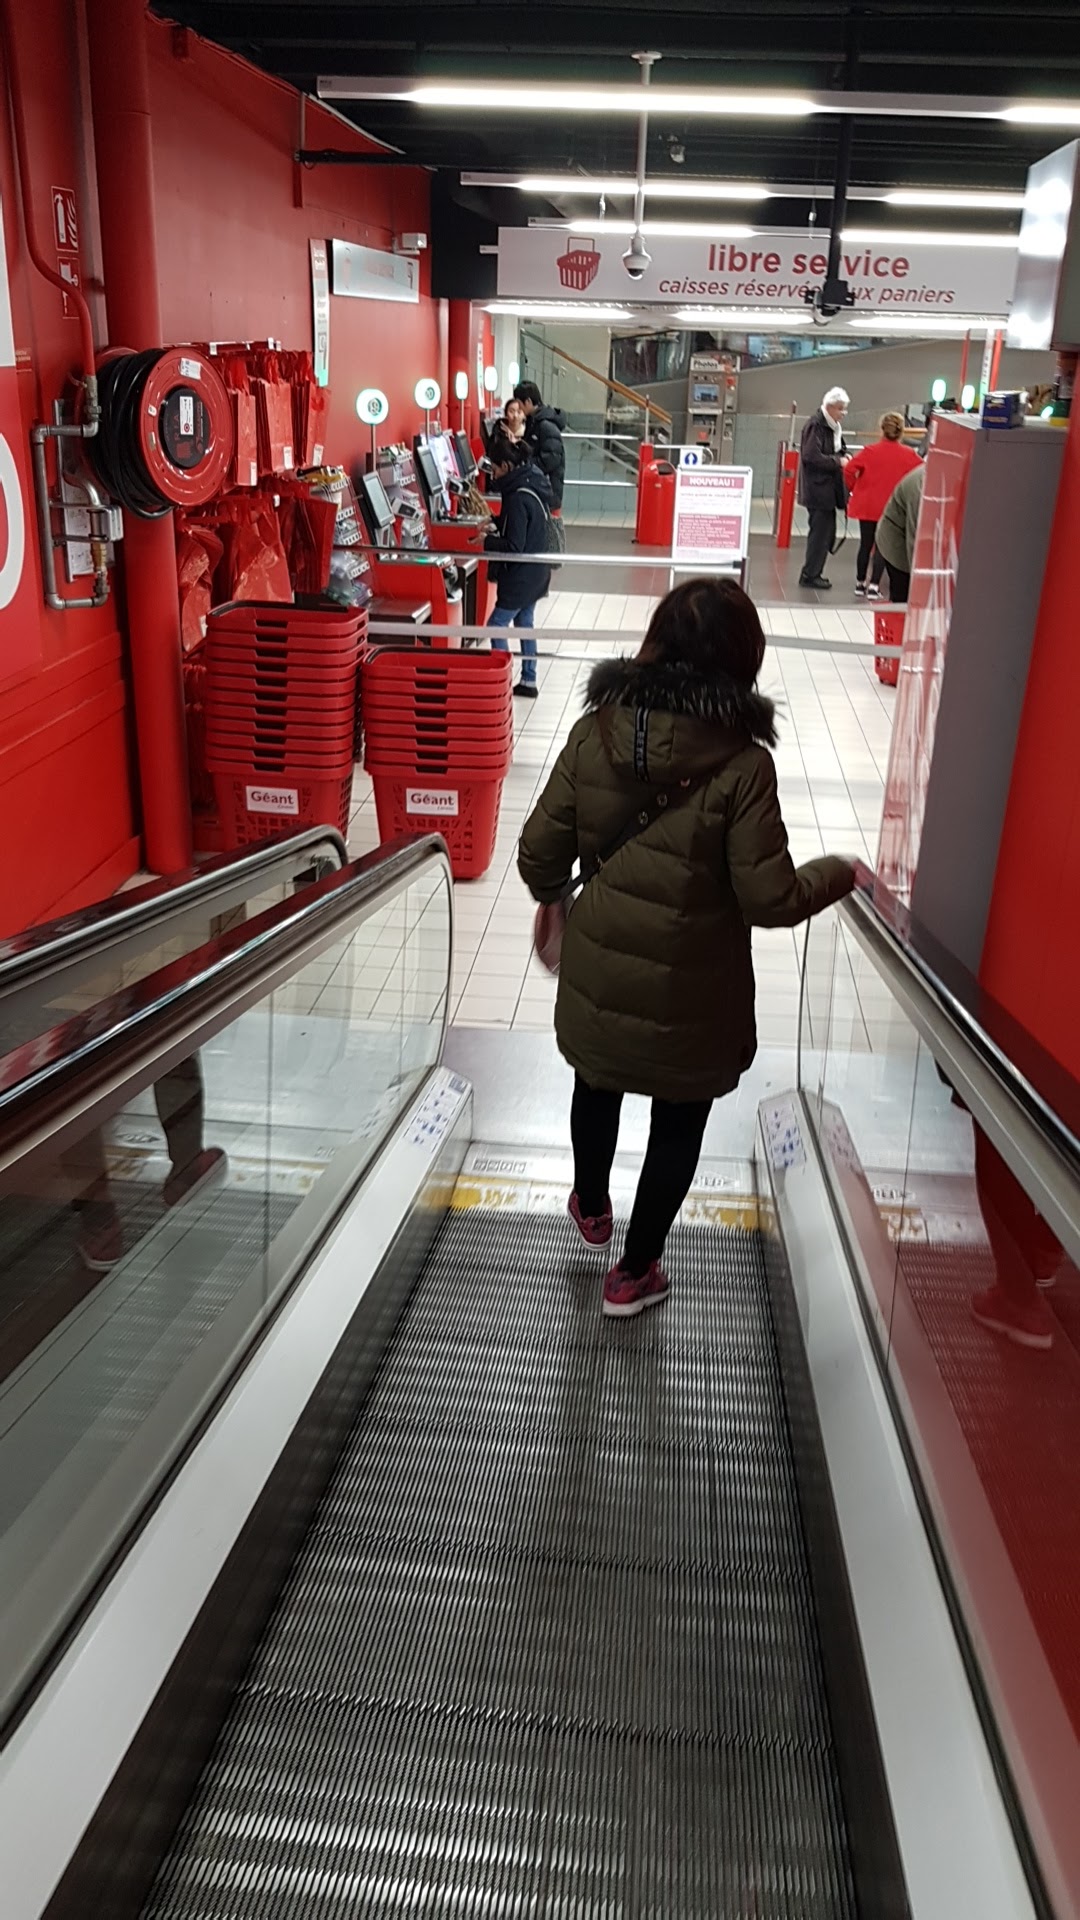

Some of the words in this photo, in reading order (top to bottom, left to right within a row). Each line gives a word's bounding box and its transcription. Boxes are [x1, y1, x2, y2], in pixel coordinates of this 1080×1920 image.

[708, 244, 781, 273] libre
[792, 247, 910, 278] sevice
[659, 276, 729, 295] caisses
[878, 285, 955, 304] paniers
[689, 476, 731, 487] NOUVEAU
[251, 791, 294, 805] Géant
[410, 792, 454, 806] Géant
